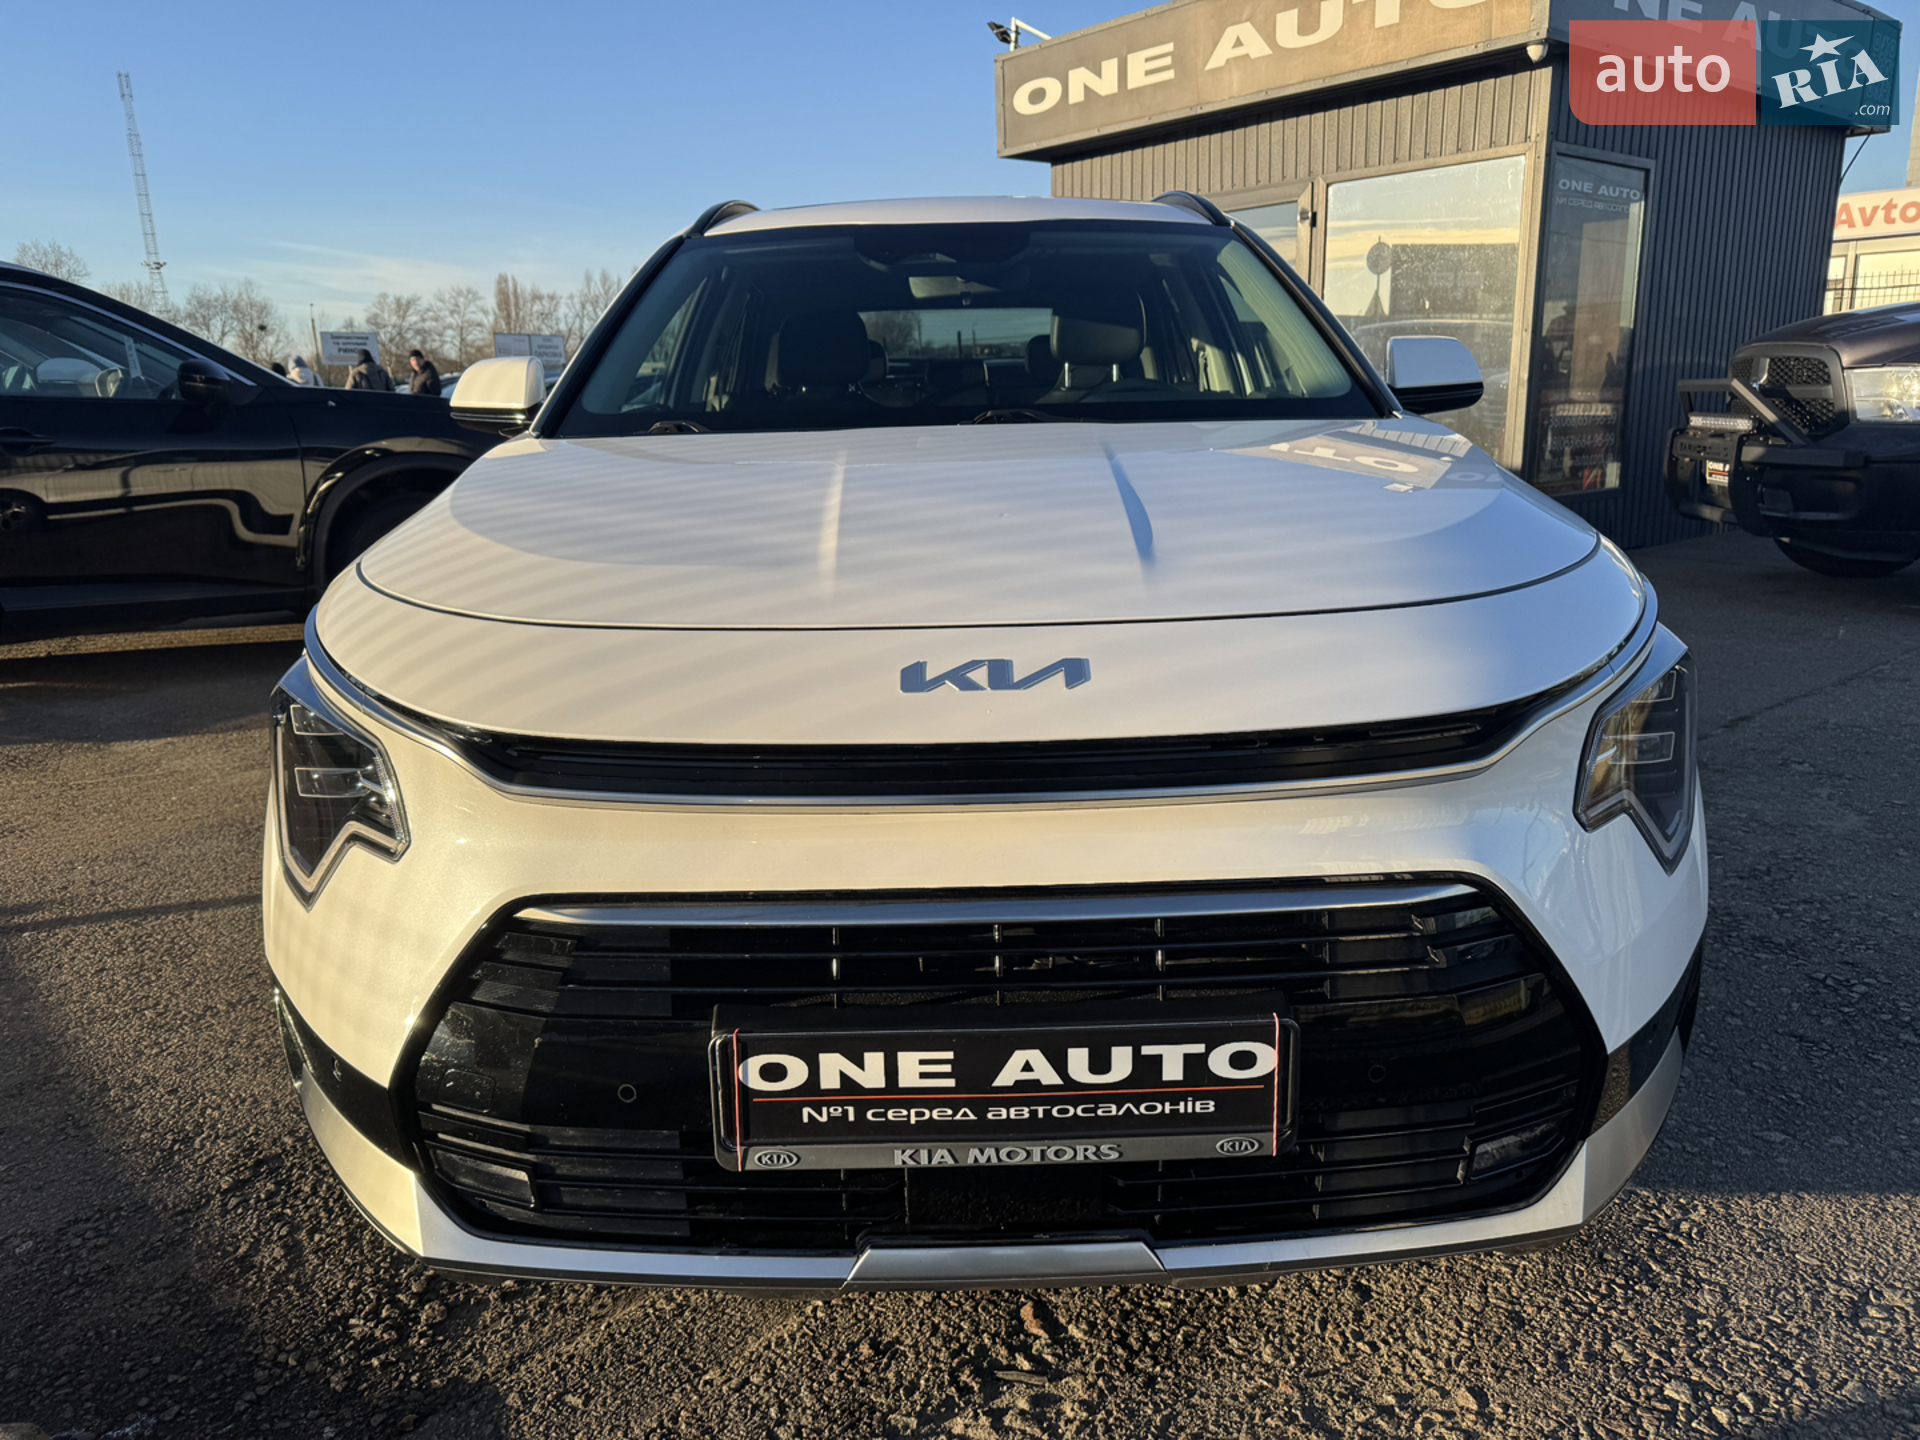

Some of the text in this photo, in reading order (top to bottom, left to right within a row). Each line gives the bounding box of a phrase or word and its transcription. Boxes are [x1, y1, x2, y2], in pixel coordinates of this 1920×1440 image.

[1013, 0, 1490, 115] ONE AUT
[1558, 178, 1641, 200] ONE AUTO
[1835, 198, 1920, 229] Avto
[900, 658, 1091, 693] KIA
[738, 1041, 1278, 1092] ONE AUTO
[866, 1107, 978, 1124] серед
[986, 1097, 1216, 1120] автосалонів
[758, 1153, 794, 1166] KIA
[894, 1144, 1122, 1165] KIA MOTORS
[1219, 1138, 1254, 1154] KIA
